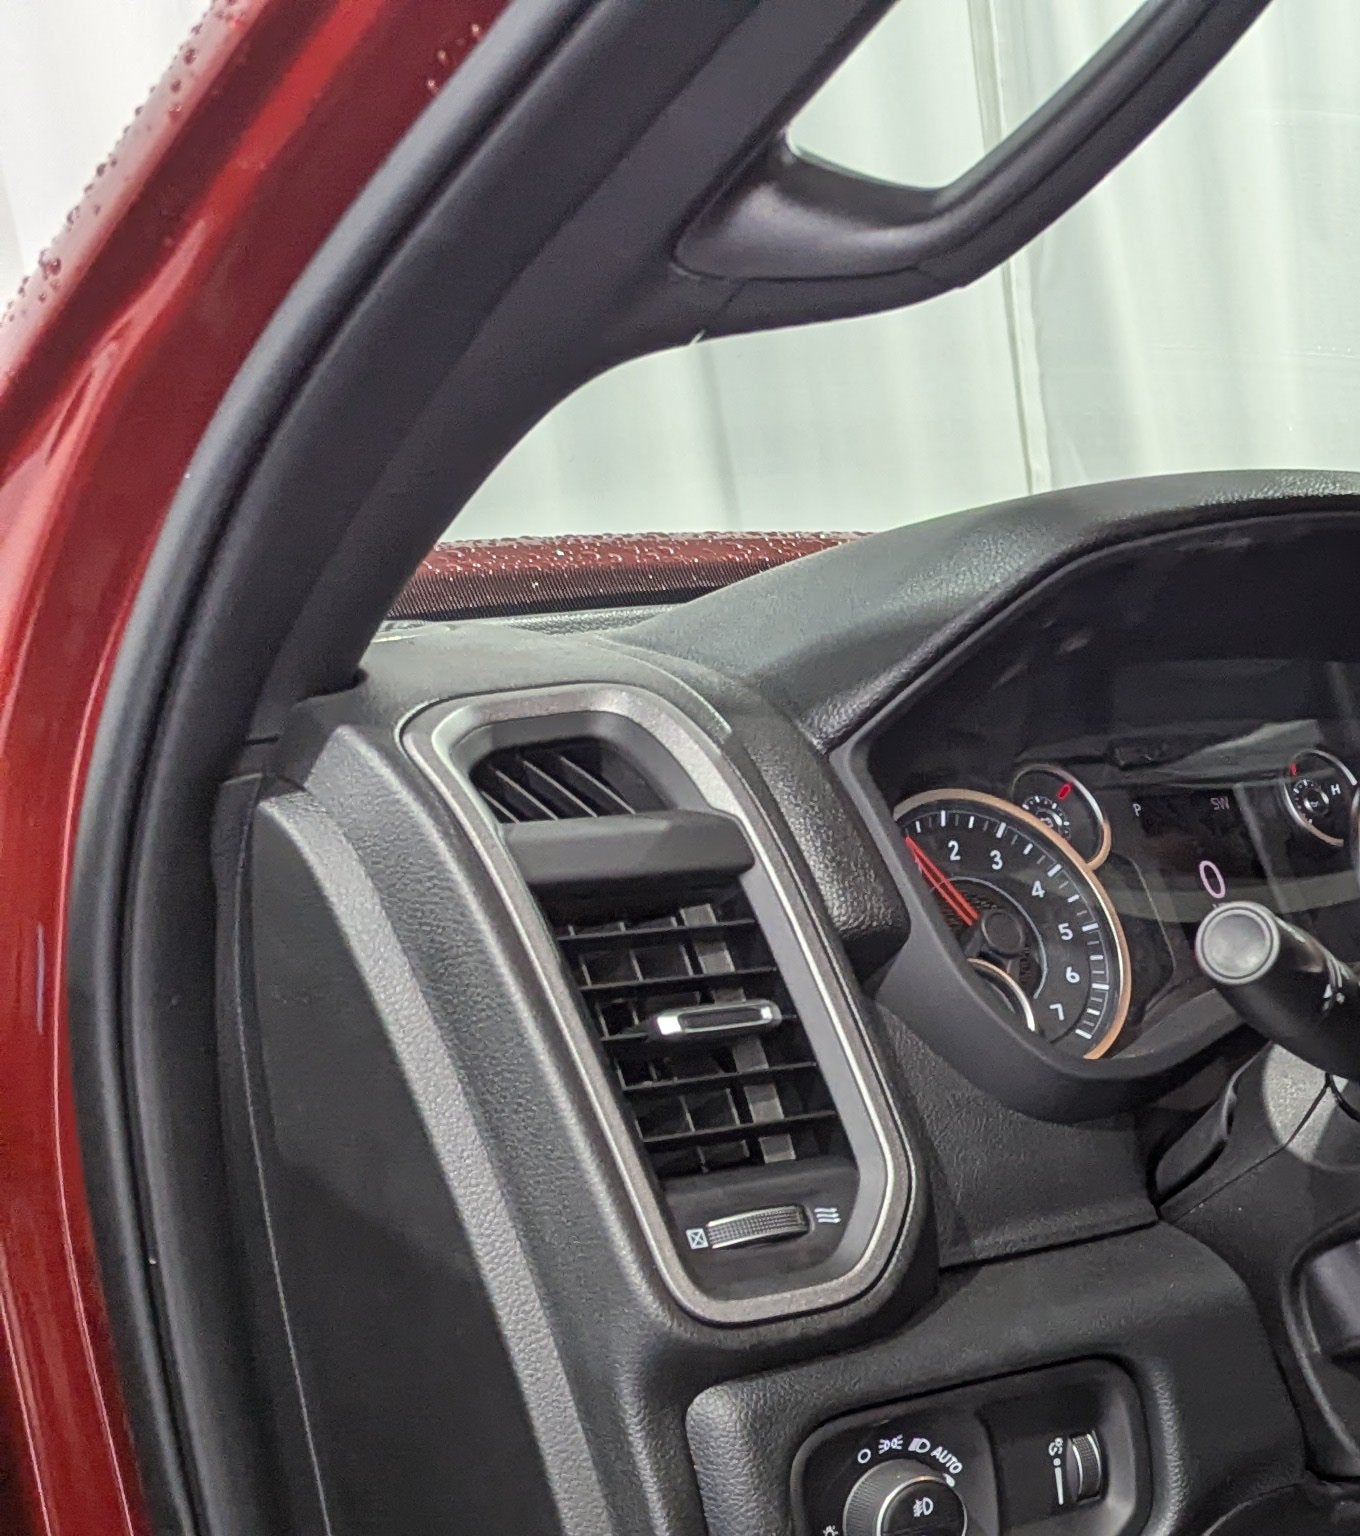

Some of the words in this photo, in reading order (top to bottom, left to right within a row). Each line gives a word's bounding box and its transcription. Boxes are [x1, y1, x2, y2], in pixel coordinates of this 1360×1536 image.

[1330, 783, 1342, 796] H
[948, 840, 961, 861] 2
[990, 849, 1003, 870] 3
[1199, 860, 1226, 899] 0
[1031, 880, 1046, 898] 4
[1058, 923, 1073, 941] 5
[1065, 966, 1081, 984] 6
[1049, 1003, 1065, 1021] 7
[930, 1446, 963, 1474] AUTO
